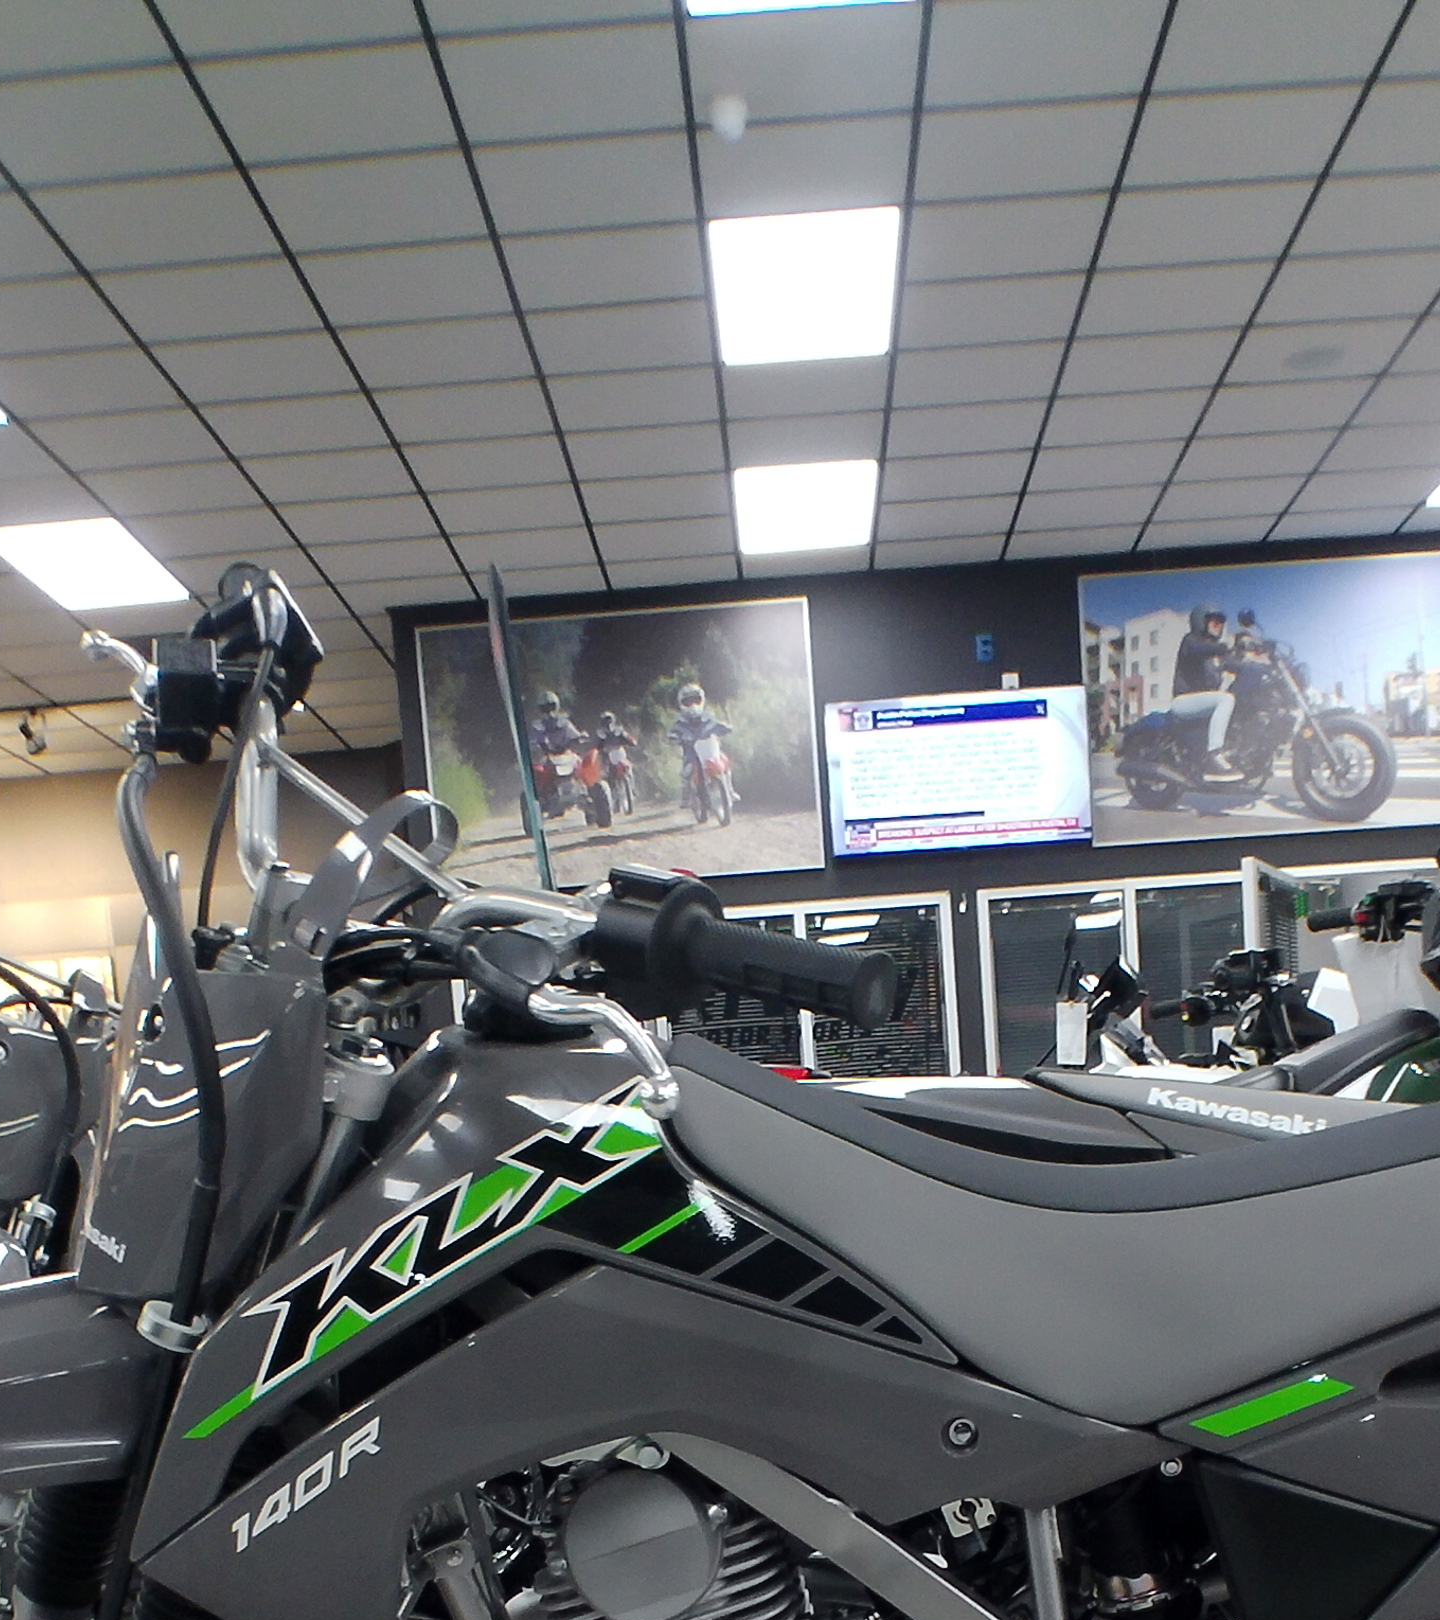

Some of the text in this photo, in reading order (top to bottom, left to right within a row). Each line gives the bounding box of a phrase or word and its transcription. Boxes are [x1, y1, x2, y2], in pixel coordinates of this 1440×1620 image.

[1147, 1087, 1328, 1135] Kawasaki
[81, 1222, 128, 1265] saki
[241, 1075, 665, 1400] KLX
[230, 1416, 382, 1554] 140R
